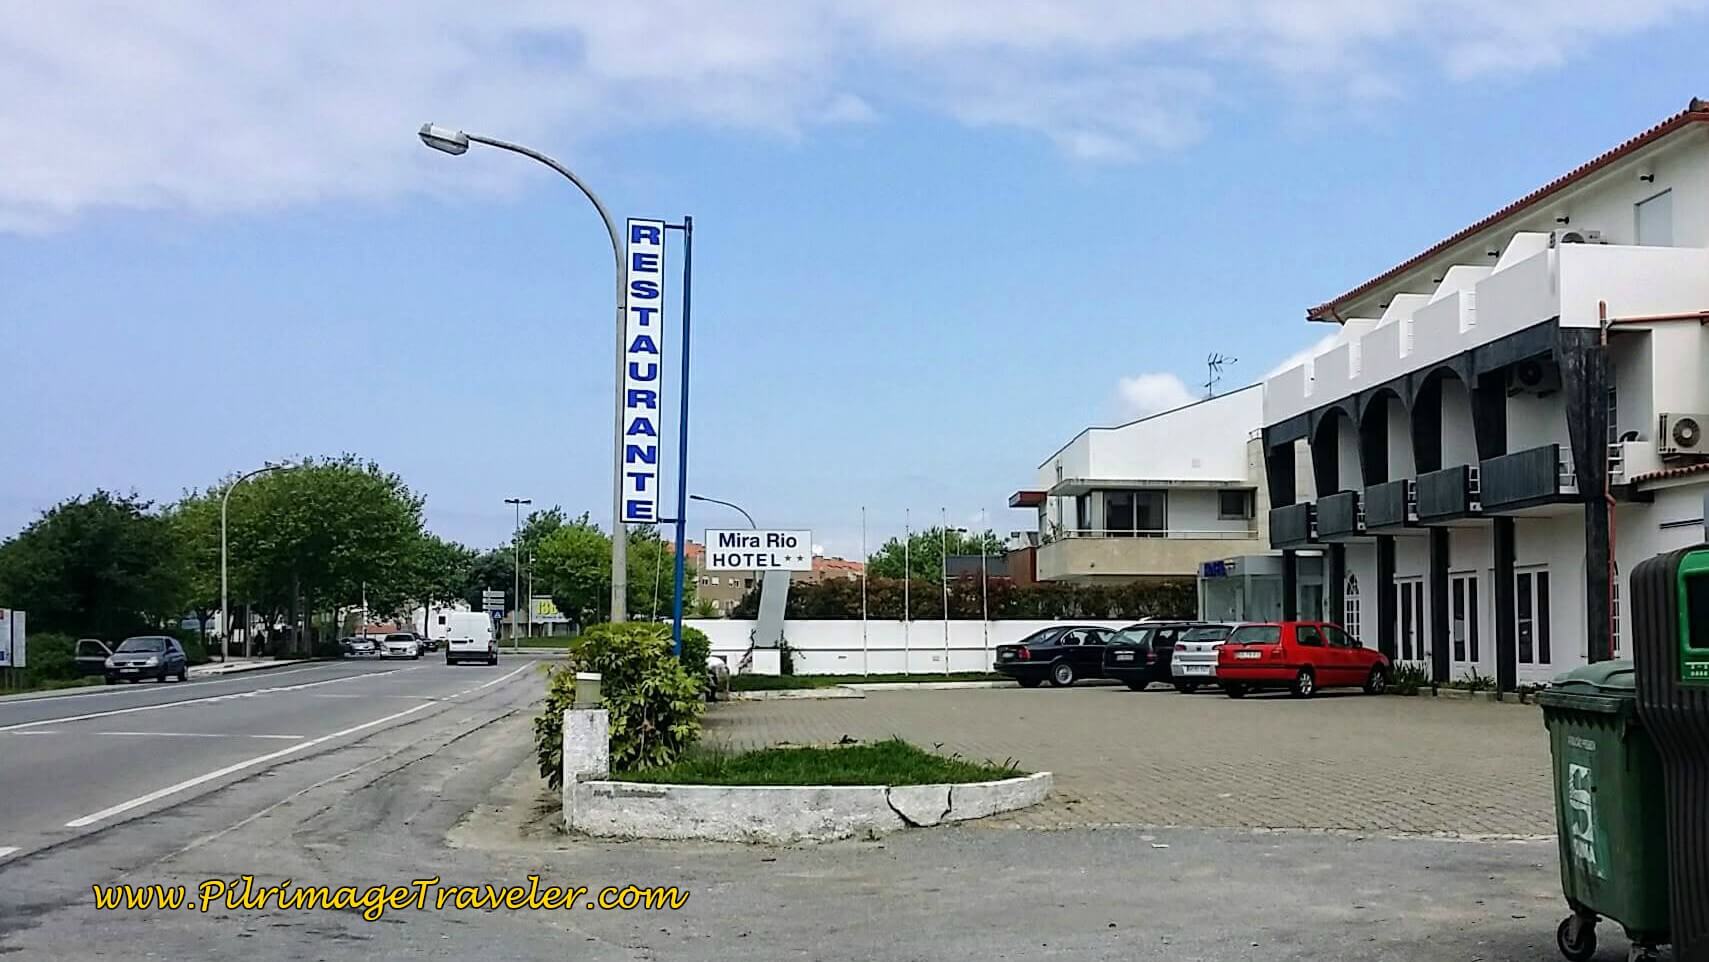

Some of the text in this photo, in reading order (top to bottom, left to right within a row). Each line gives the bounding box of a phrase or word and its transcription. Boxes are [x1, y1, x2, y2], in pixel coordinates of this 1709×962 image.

[626, 224, 661, 520] RESTAURANTE
[718, 532, 798, 548] Mira Rio
[712, 553, 781, 567] HOTEL
